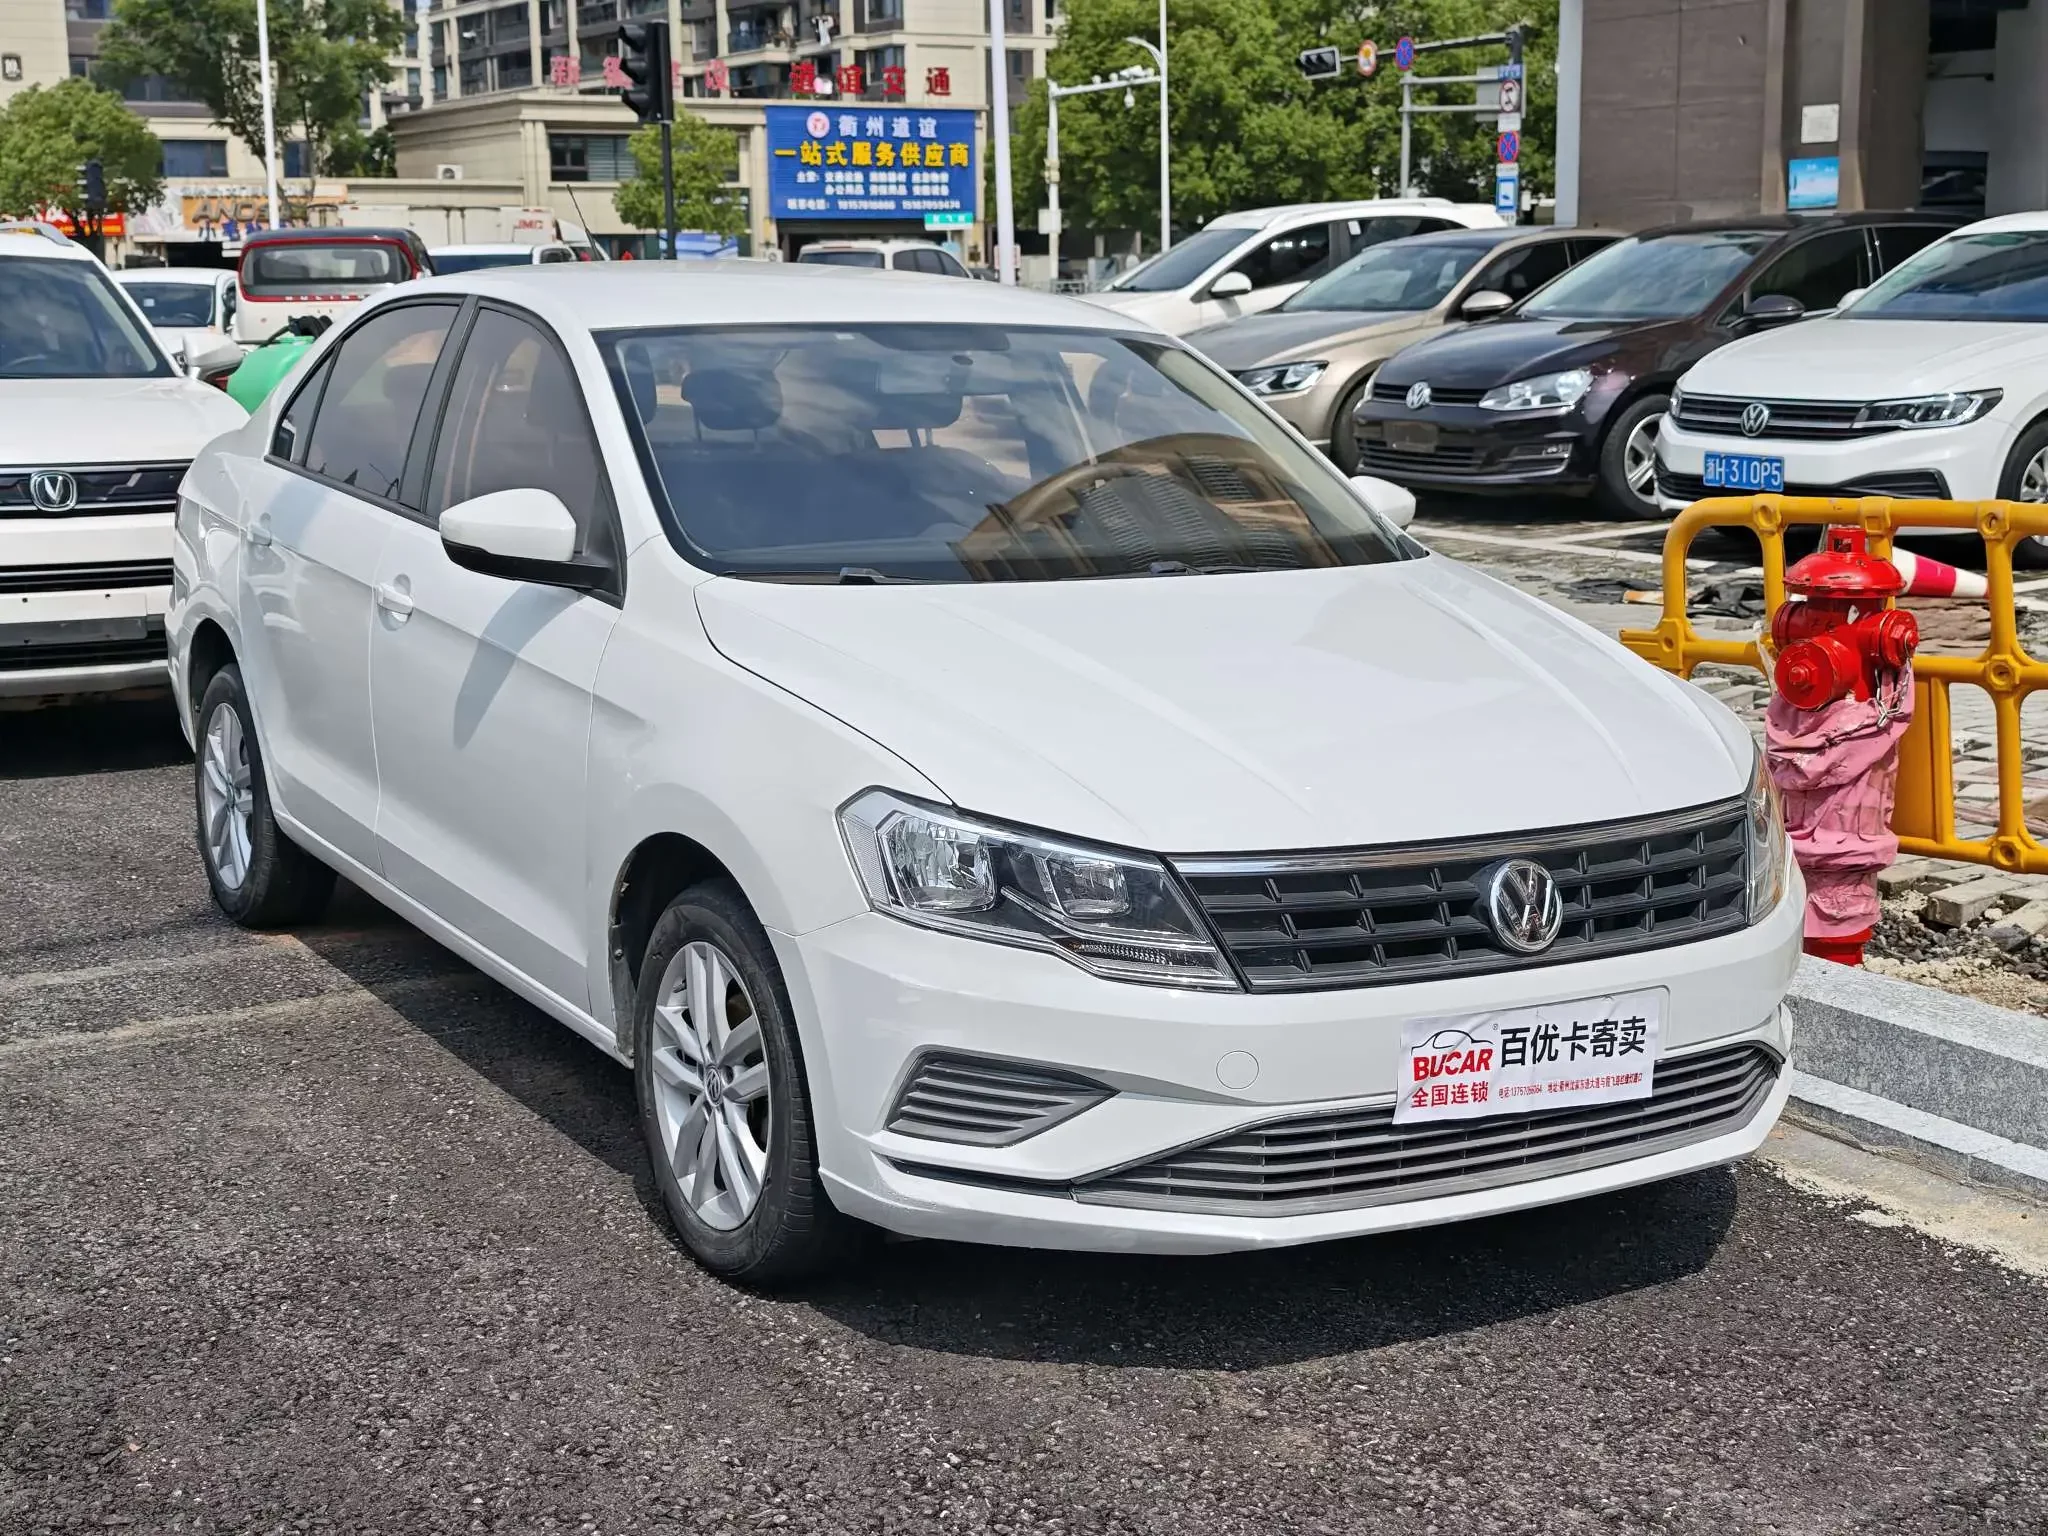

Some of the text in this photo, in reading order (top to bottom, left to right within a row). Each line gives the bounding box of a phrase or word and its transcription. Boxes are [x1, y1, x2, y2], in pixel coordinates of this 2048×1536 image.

[838, 115, 937, 138] 衢州道谊
[774, 141, 969, 167] 一站式服务供应商
[1500, 1015, 1647, 1068] 百优卡寄卖
[1413, 1048, 1494, 1082] BUCAR
[1410, 1081, 1489, 1109] 全国连锁
